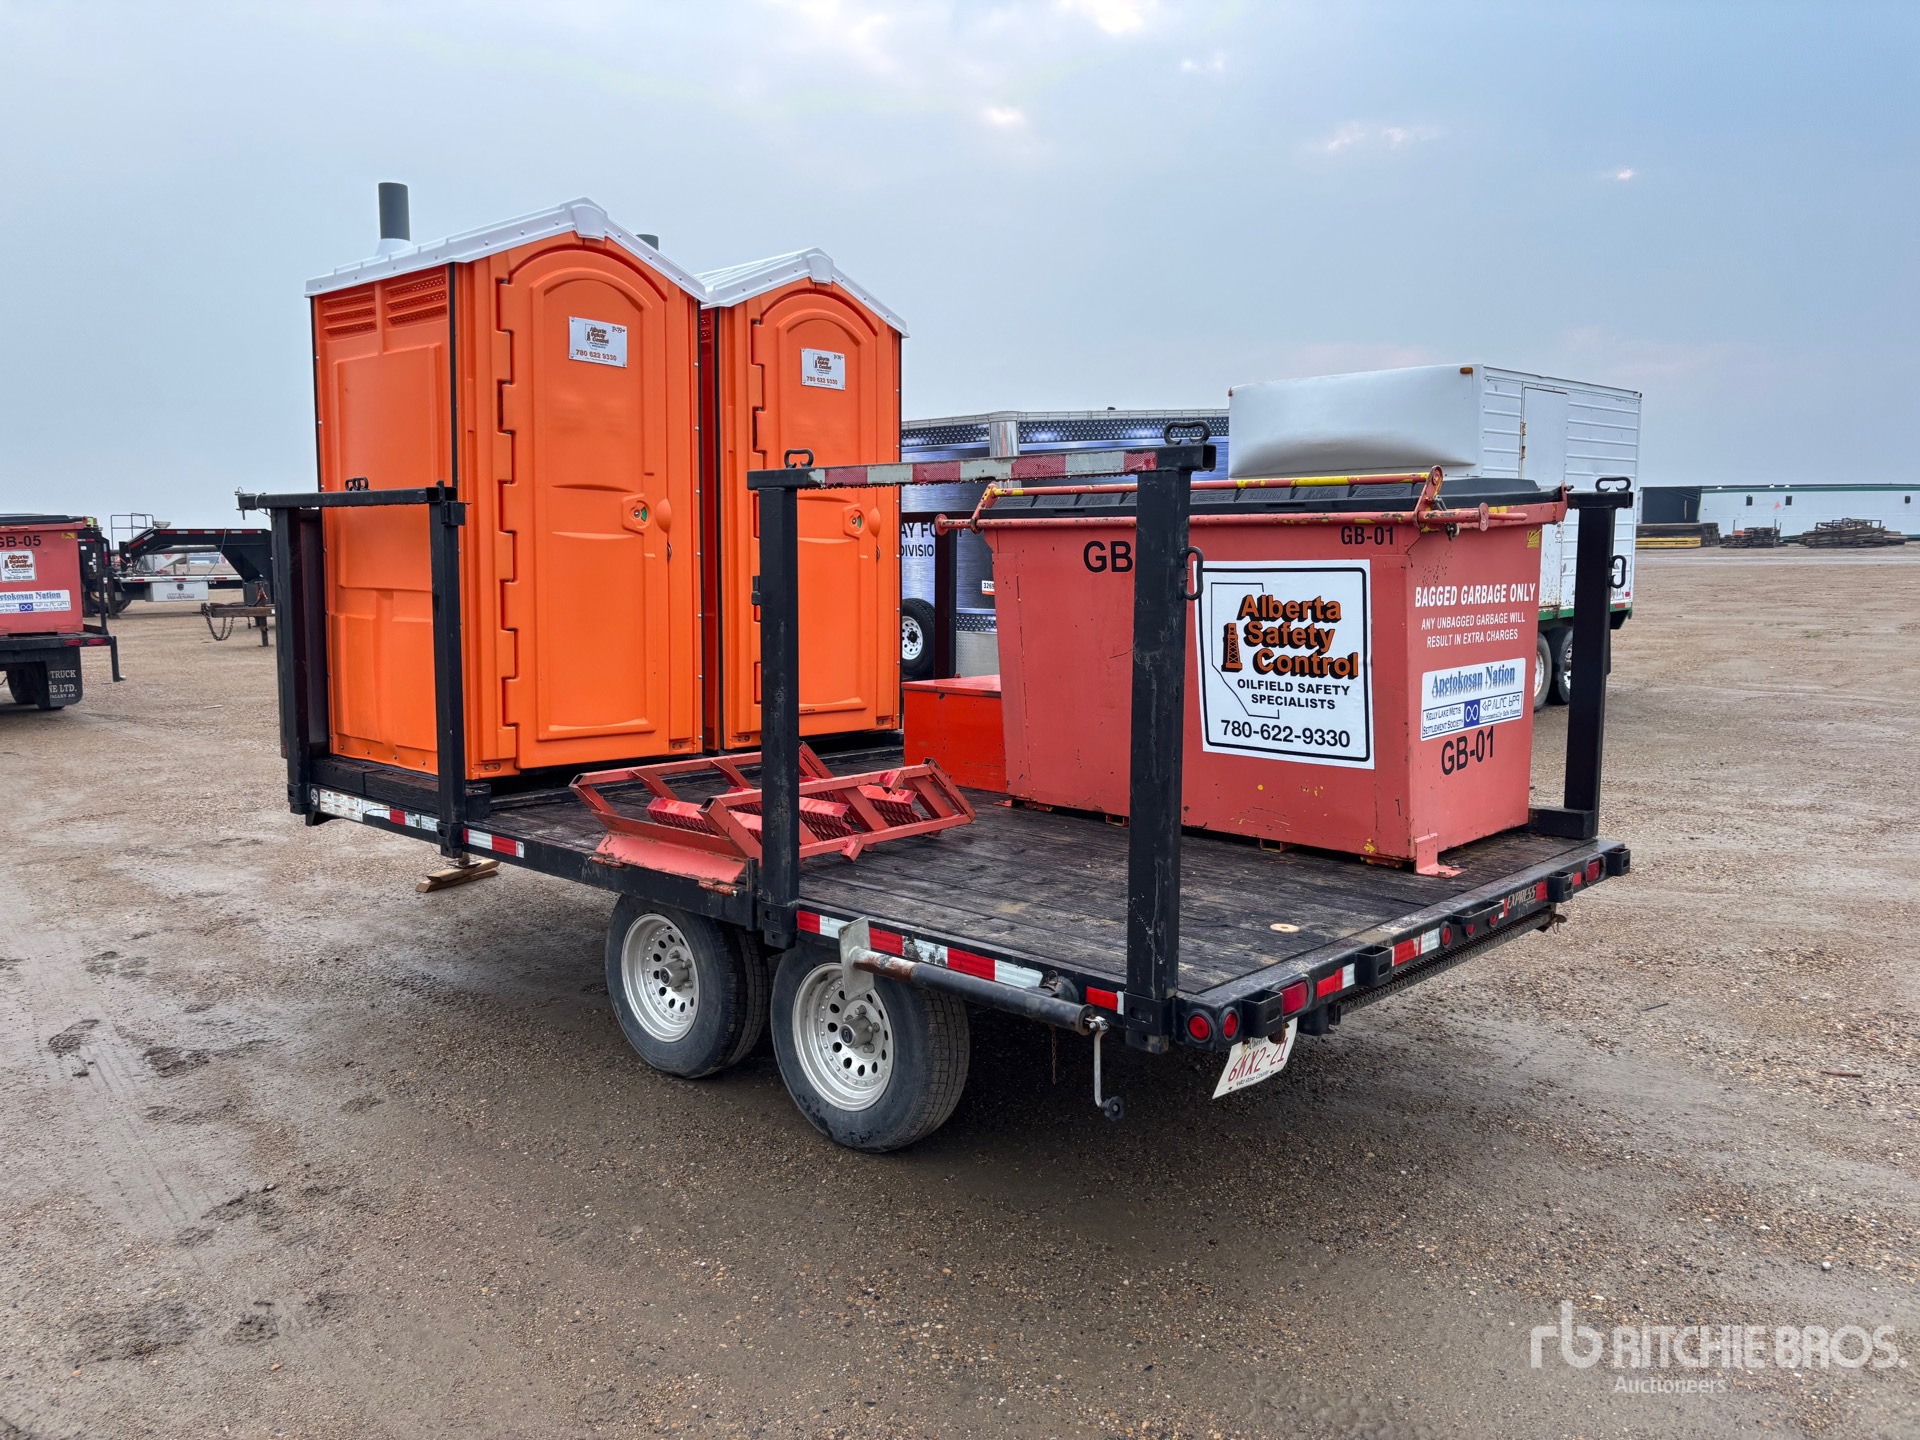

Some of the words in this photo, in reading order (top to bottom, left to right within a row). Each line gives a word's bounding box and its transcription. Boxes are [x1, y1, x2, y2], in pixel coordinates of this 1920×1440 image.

[1341, 526, 1394, 545] GB-01
[901, 544, 934, 557] DIVISIO
[1415, 586, 1457, 608] BAGGED
[1460, 584, 1506, 605] GARBAGE
[1510, 583, 1536, 602] ONLY
[1236, 595, 1342, 622] Alberta
[1421, 617, 1435, 630] ANY
[1437, 615, 1475, 629] UNBAGGED
[1476, 612, 1508, 625] GARBAGE
[1510, 612, 1525, 624] WILL
[1244, 620, 1335, 653] Safety
[1427, 634, 1452, 648] RESULT
[1454, 633, 1462, 645] IN
[1463, 631, 1484, 644] EXTRA
[1486, 628, 1518, 642] CHARGES
[50, 670, 76, 678] TRUCK
[1253, 648, 1358, 680] Control
[1485, 664, 1515, 684] Nation
[60, 684, 77, 692] LTD.
[1237, 678, 1294, 693] OILFIELD
[1297, 682, 1350, 696] SAFETY
[1251, 694, 1336, 710] SPECIALISTS
[1221, 720, 1350, 748] 780-622-9330
[1441, 725, 1494, 776] GB-01
[1508, 885, 1536, 909] EXPRESS
